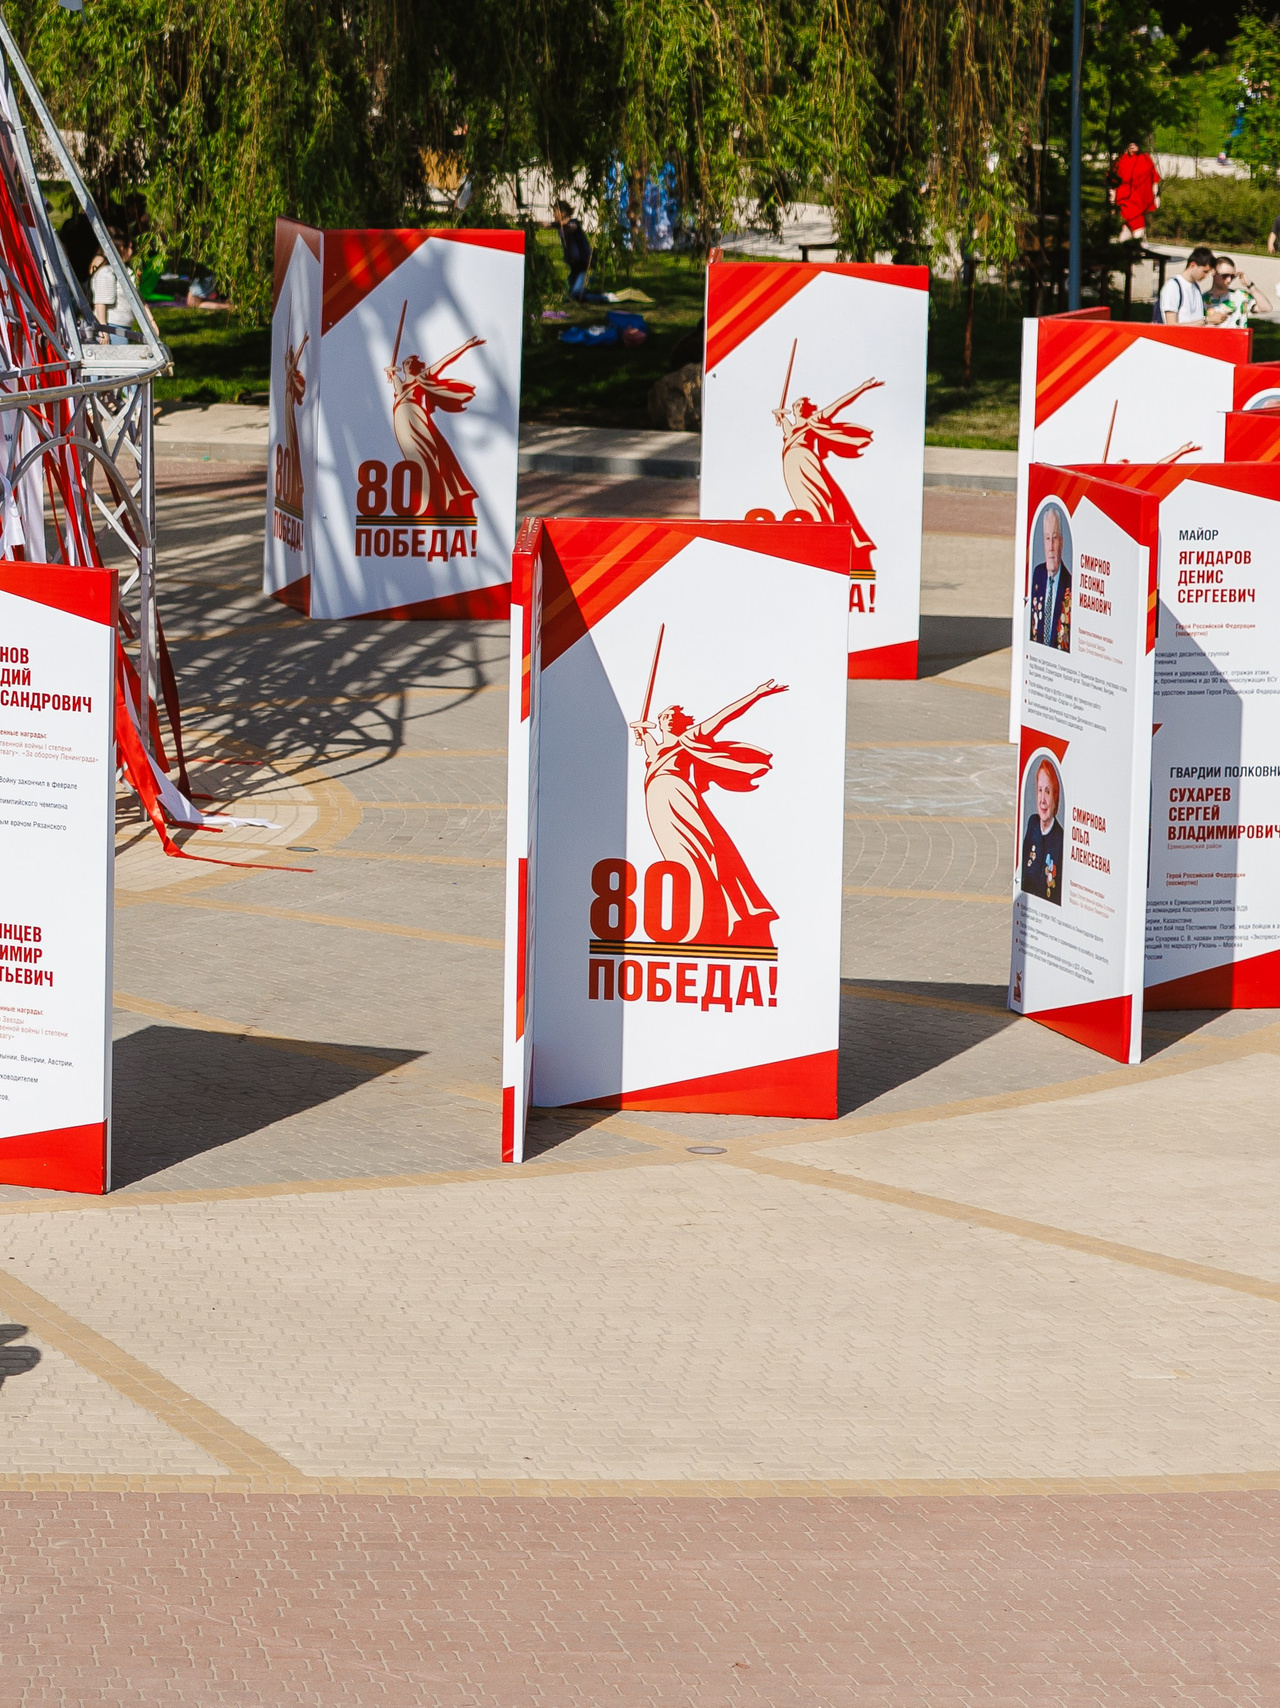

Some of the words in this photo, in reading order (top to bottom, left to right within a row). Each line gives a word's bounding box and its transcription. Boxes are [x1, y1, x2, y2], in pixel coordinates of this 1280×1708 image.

[275, 443, 290, 504] 80
[356, 460, 423, 516] 80
[274, 510, 304, 552] ПОБЕДА!
[1178, 528, 1219, 541] МАЙОР
[355, 528, 478, 562] ПОБЕДА!
[1080, 554, 1110, 576] СМИРНОВ
[1178, 550, 1252, 567] ЯГИДАРОВ
[1080, 573, 1105, 597] ЛЕОНИД
[1178, 570, 1224, 586] ДЕНИС
[1079, 592, 1112, 617] ИВАНОВИЧ
[1178, 588, 1256, 604] СЕРГЕЕВИЧ
[1170, 766, 1221, 780] ГВАРДИИ
[1170, 787, 1231, 802] СУХАРЕВ
[1072, 806, 1106, 833] СМИРНОВА
[1169, 805, 1220, 821] СЕРГЕЙ
[1072, 826, 1090, 846] ОЛЬГА
[1168, 825, 1280, 842] ВЛАДИМИРОВИЧ
[1070, 846, 1111, 874] АЛЕКСЕЕВНА
[590, 858, 691, 942] 80
[588, 958, 778, 1012] ПОБЕДА!
